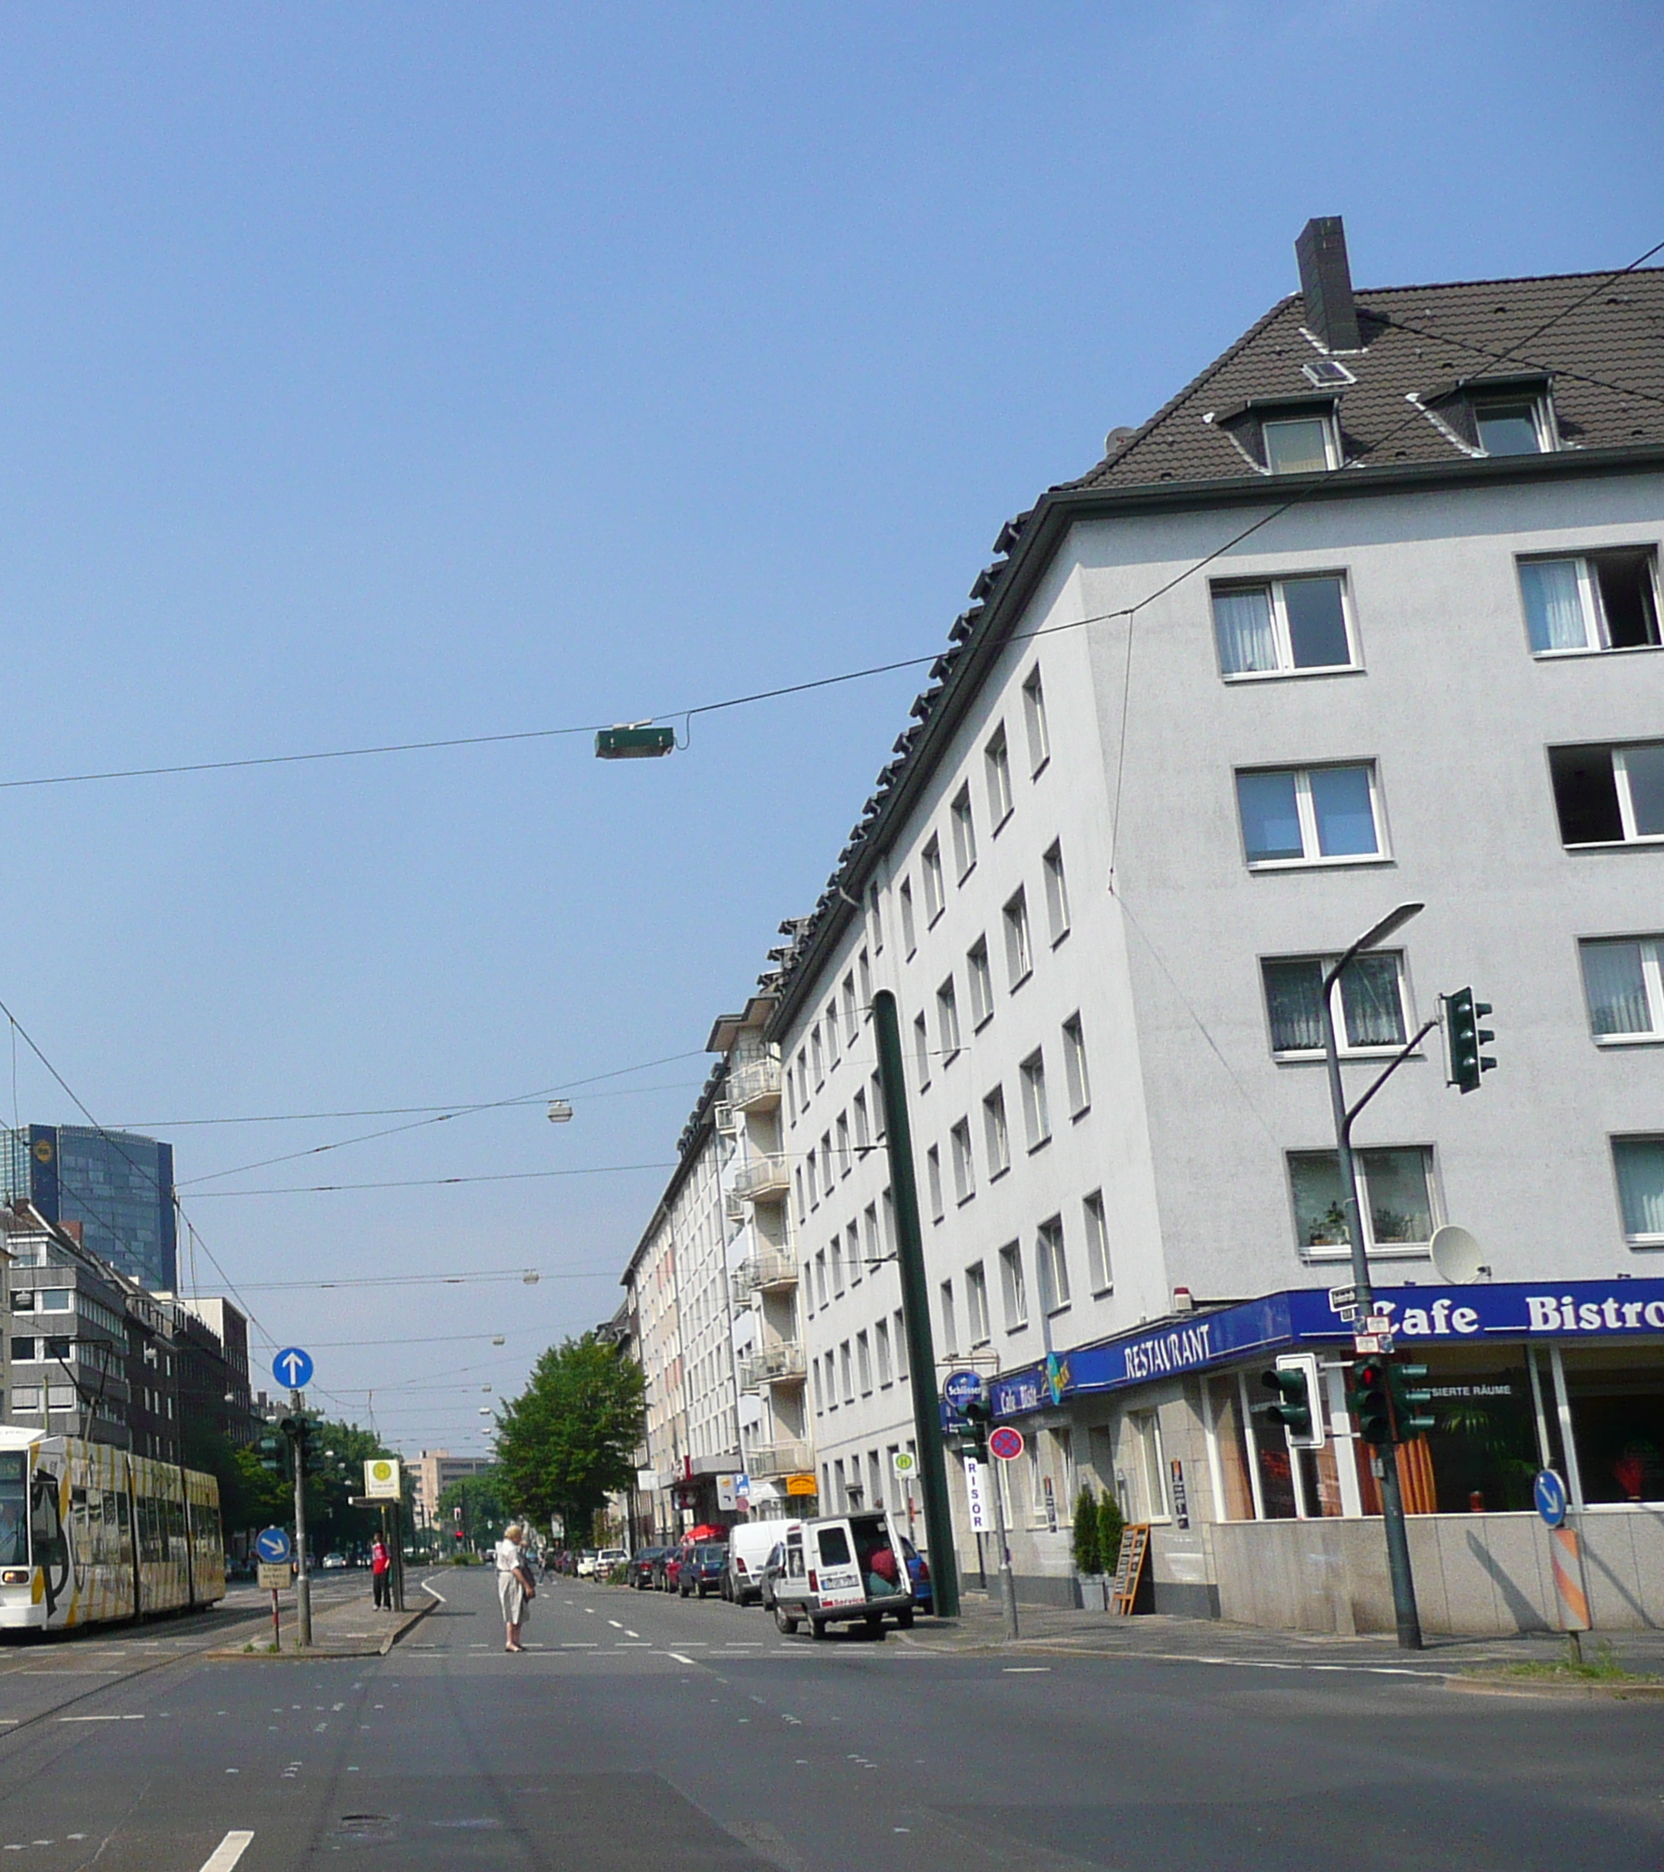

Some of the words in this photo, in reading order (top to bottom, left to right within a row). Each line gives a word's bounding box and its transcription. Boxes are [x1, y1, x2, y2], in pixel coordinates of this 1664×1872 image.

[1373, 1299, 1479, 1335] Cafe
[1526, 1296, 1664, 1331] Bistro
[1473, 1384, 1512, 1396] RÄUME
[833, 1597, 866, 1606] Service
